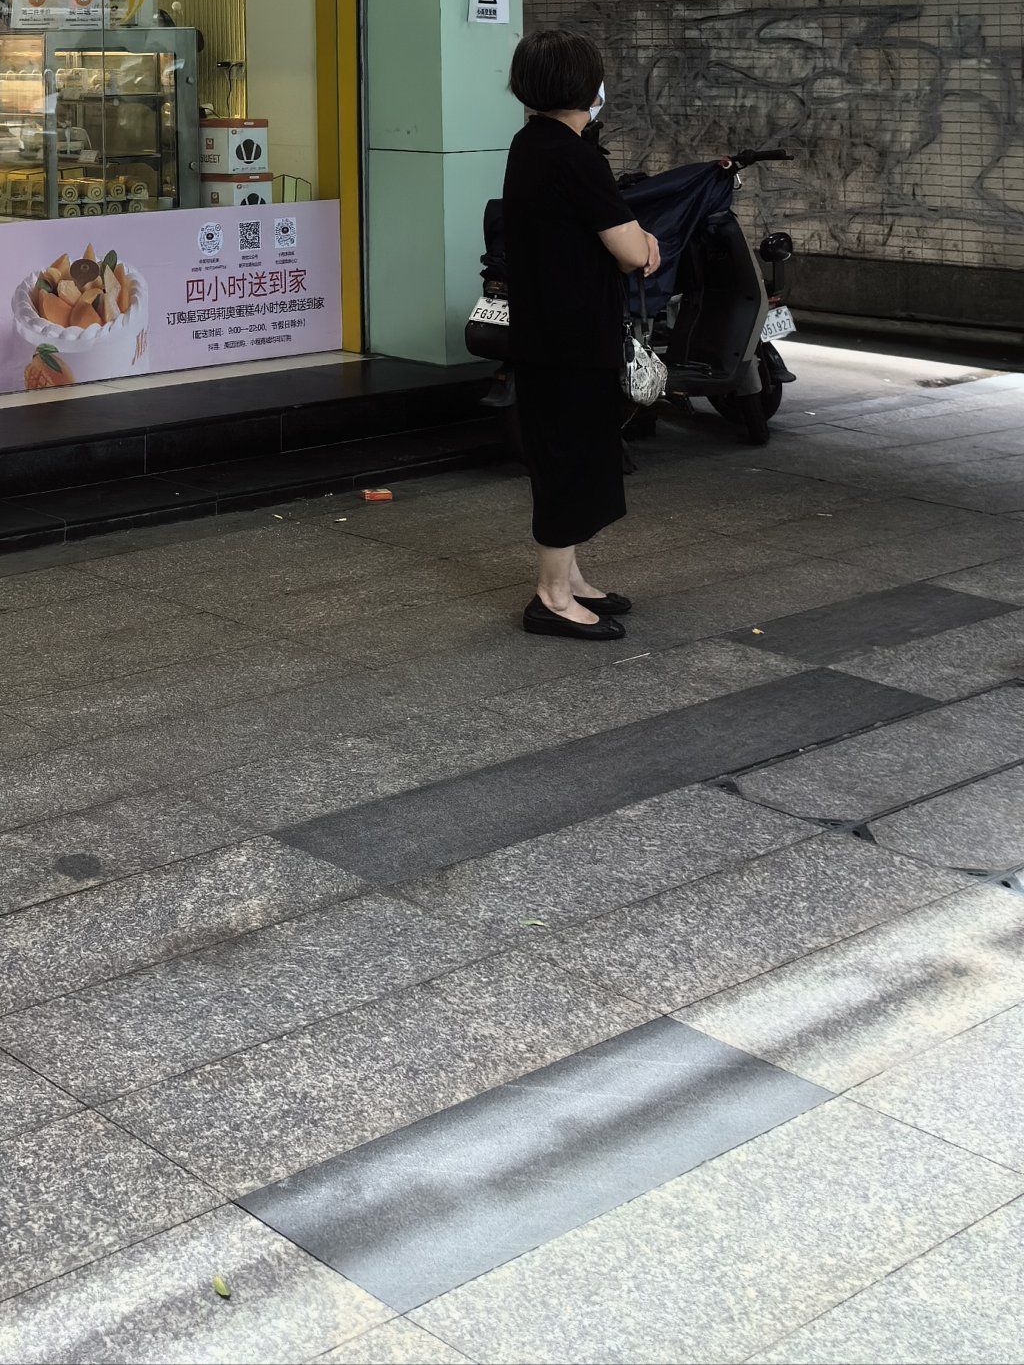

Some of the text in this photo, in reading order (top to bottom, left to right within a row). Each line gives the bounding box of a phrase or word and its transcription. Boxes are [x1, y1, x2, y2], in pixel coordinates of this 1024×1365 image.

[186, 268, 307, 304] 四小时送到家
[473, 307, 510, 323] FG372
